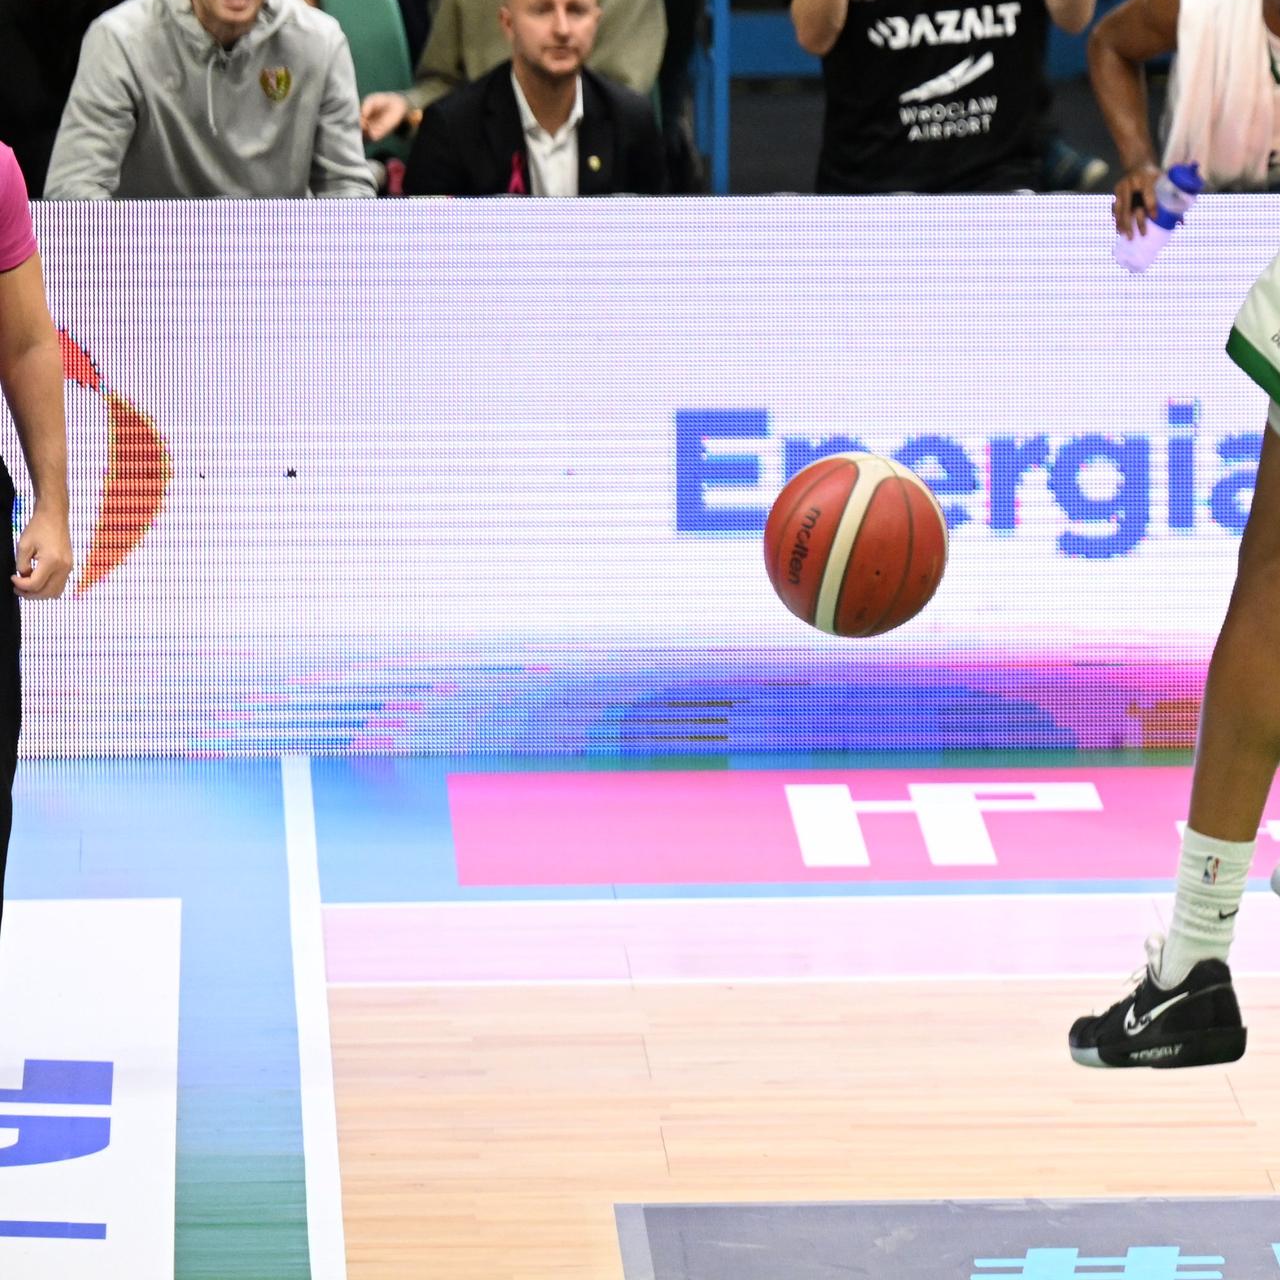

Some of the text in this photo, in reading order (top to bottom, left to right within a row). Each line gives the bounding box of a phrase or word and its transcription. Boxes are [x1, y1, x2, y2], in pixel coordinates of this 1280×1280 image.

[884, 1, 1022, 50] BAZALT
[907, 114, 992, 142] AIRPORT
[787, 505, 821, 585] molten
